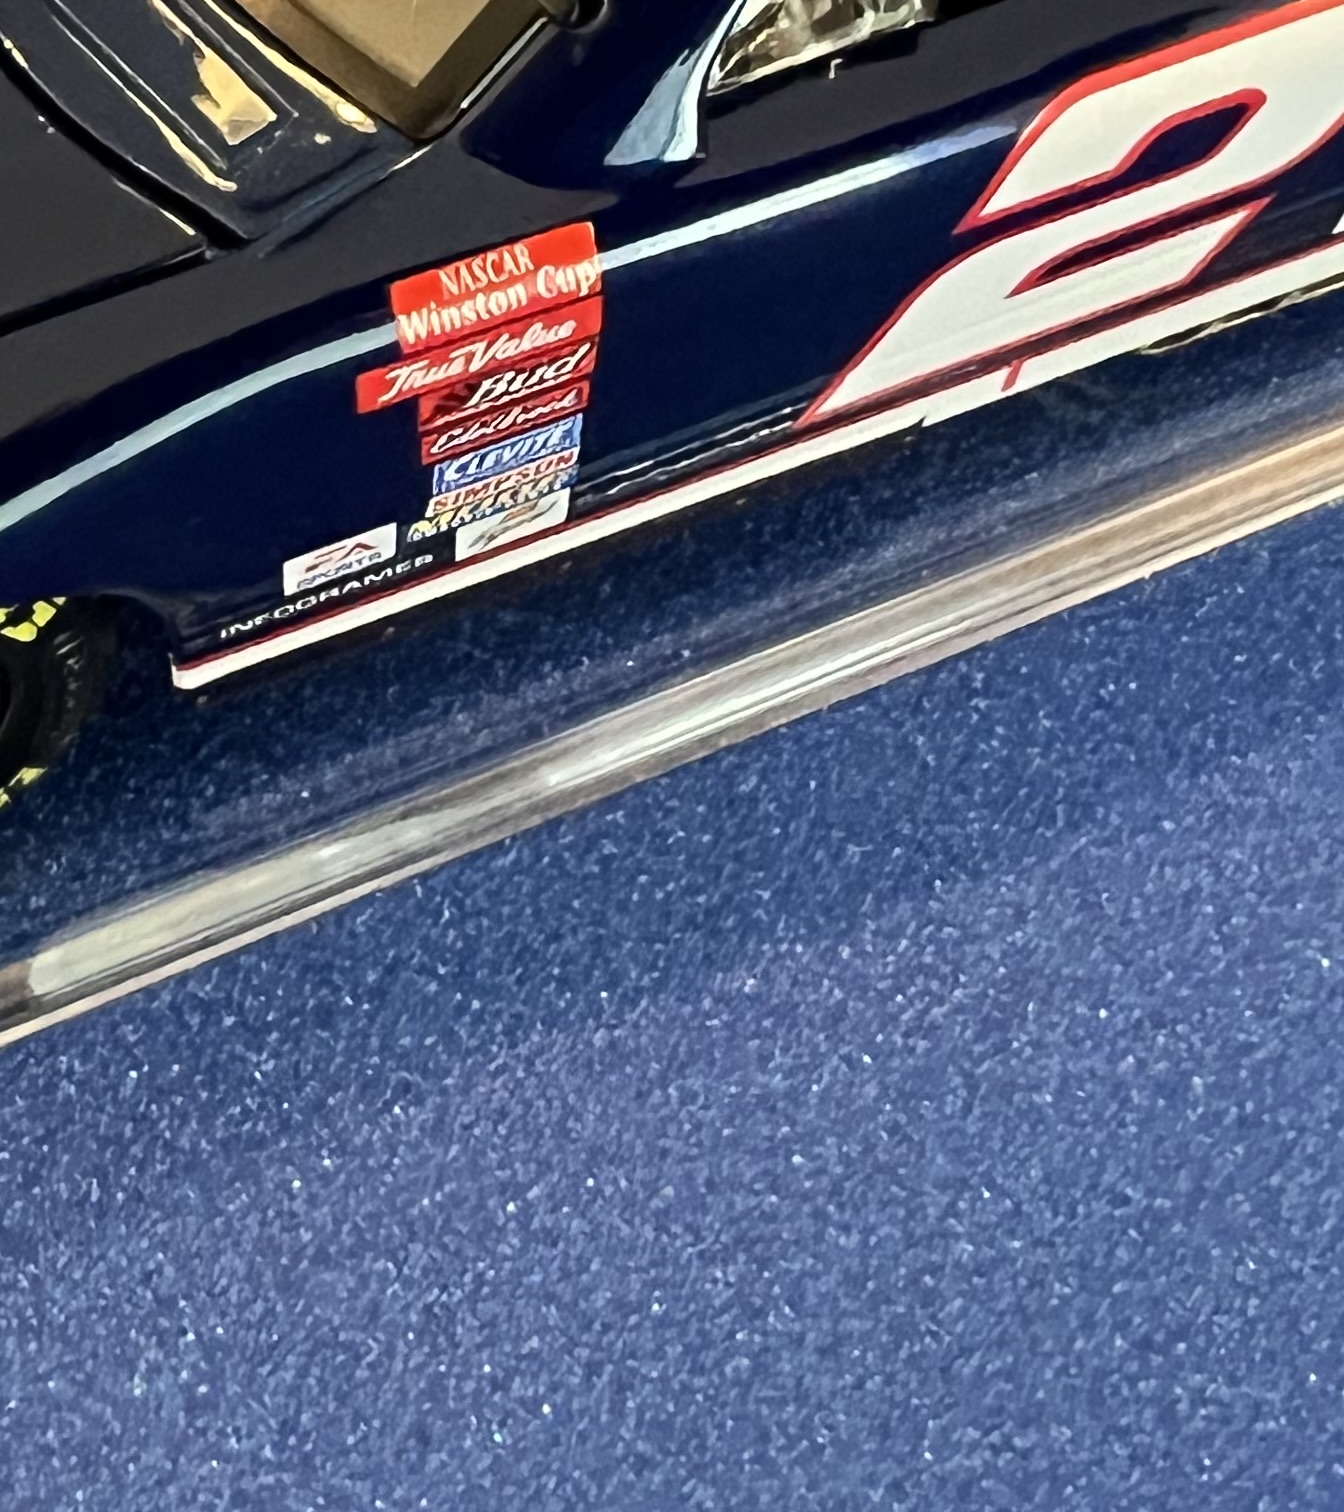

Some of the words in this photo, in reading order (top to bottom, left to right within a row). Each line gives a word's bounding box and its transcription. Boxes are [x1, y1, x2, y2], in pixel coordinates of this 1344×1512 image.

[395, 284, 528, 345] Winston
[536, 257, 600, 299] Cup
[438, 243, 534, 300] NASCAR
[462, 341, 592, 409] Bud
